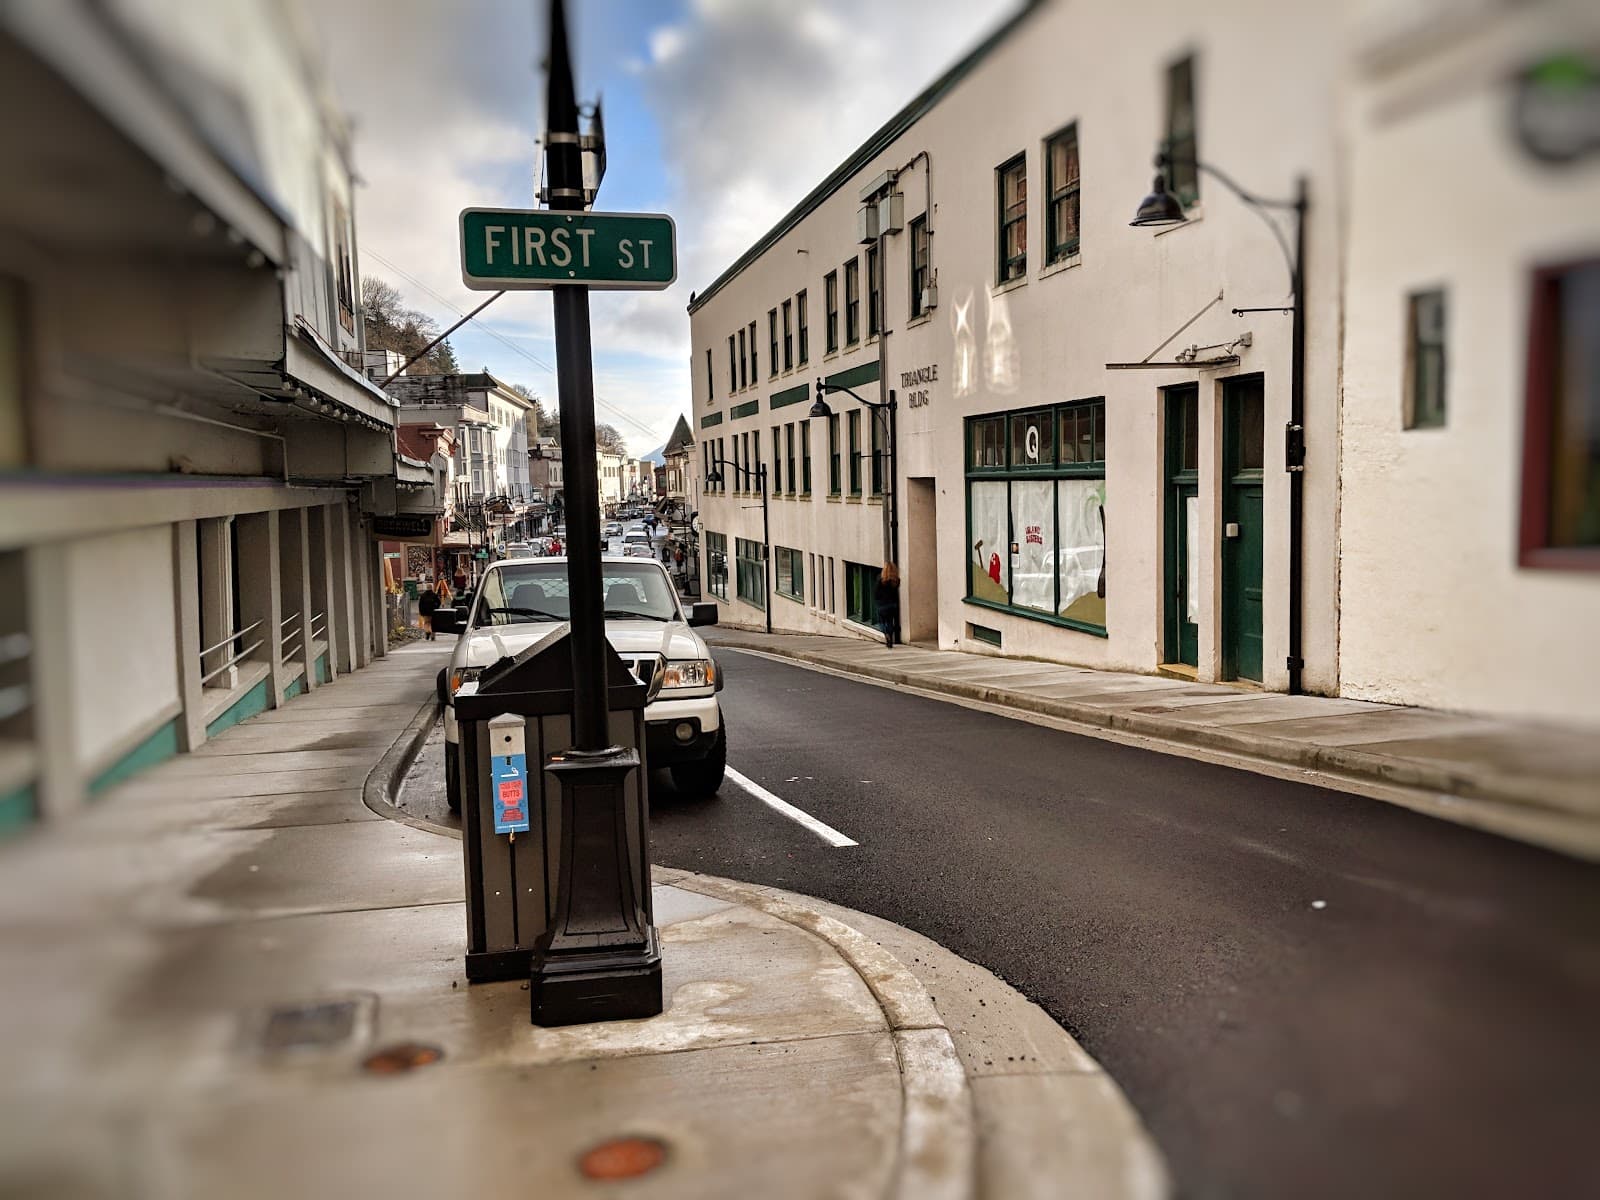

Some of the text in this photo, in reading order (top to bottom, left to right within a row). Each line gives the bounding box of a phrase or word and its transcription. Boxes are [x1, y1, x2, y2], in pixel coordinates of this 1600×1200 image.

[484, 225, 653, 269] FIRST ST
[900, 364, 938, 389] TRIANGLE
[908, 389, 929, 409] BLDG
[1025, 425, 1039, 464] Q
